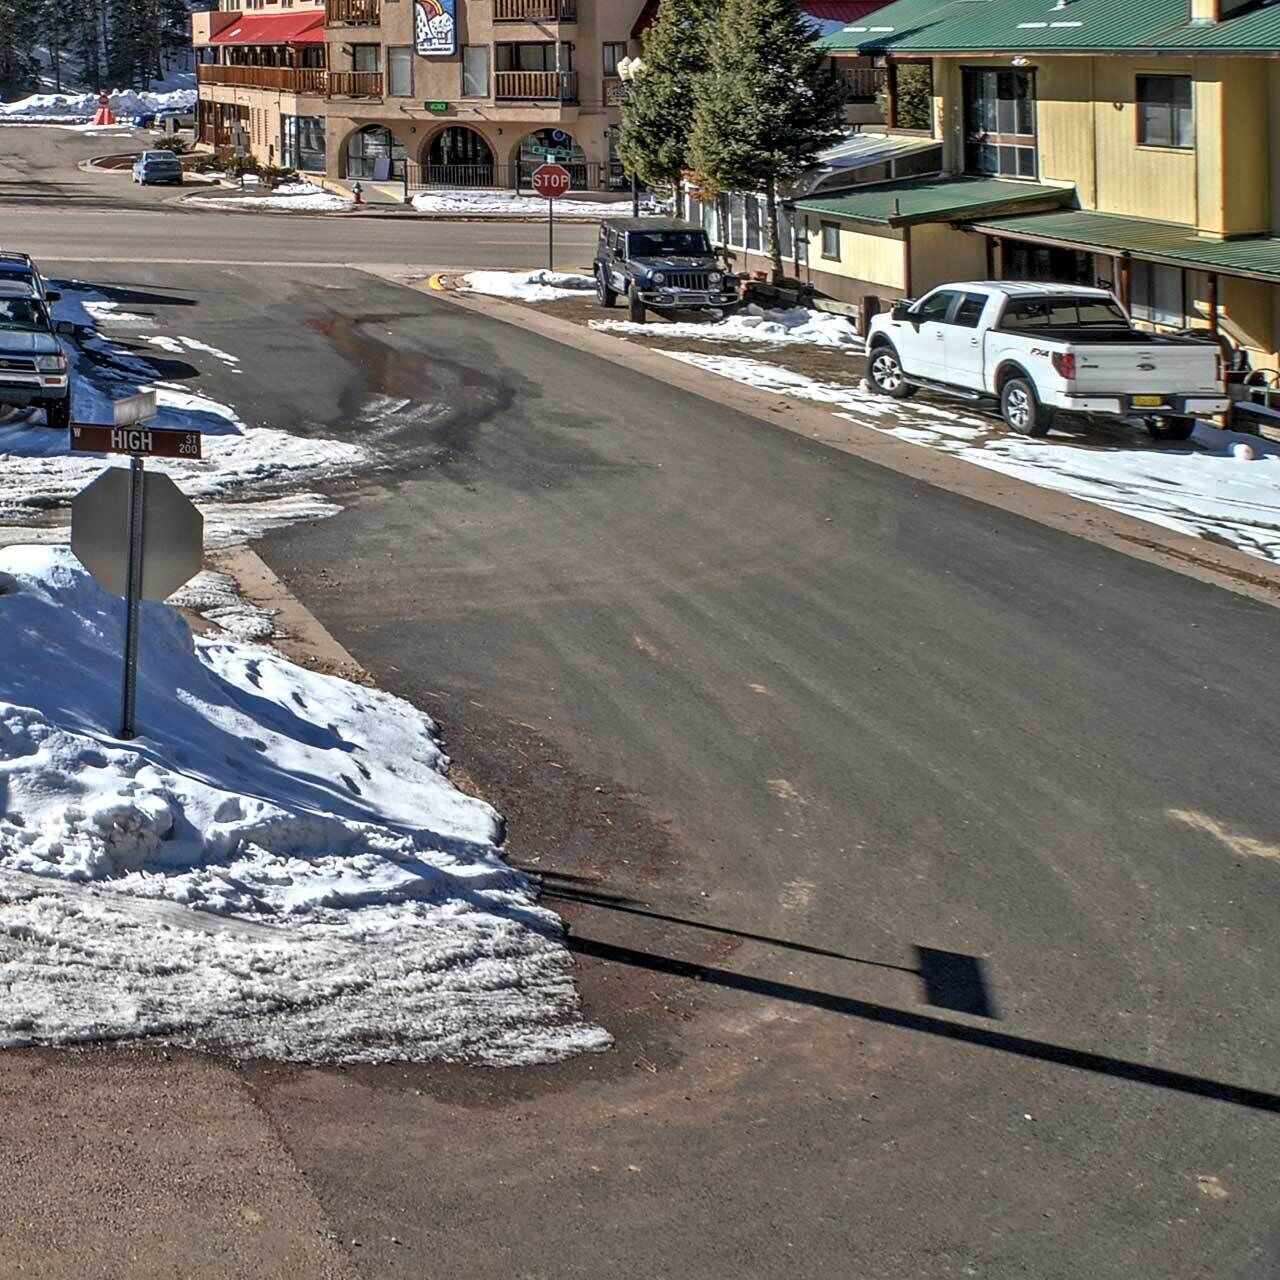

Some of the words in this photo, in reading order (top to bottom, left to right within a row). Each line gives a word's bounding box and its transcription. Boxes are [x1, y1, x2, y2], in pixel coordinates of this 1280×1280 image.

[533, 174, 569, 188] STOP
[1031, 348, 1050, 357] FX4
[73, 427, 82, 437] W
[111, 429, 153, 451] HIGH
[186, 435, 197, 444] ST
[179, 444, 197, 453] 200
